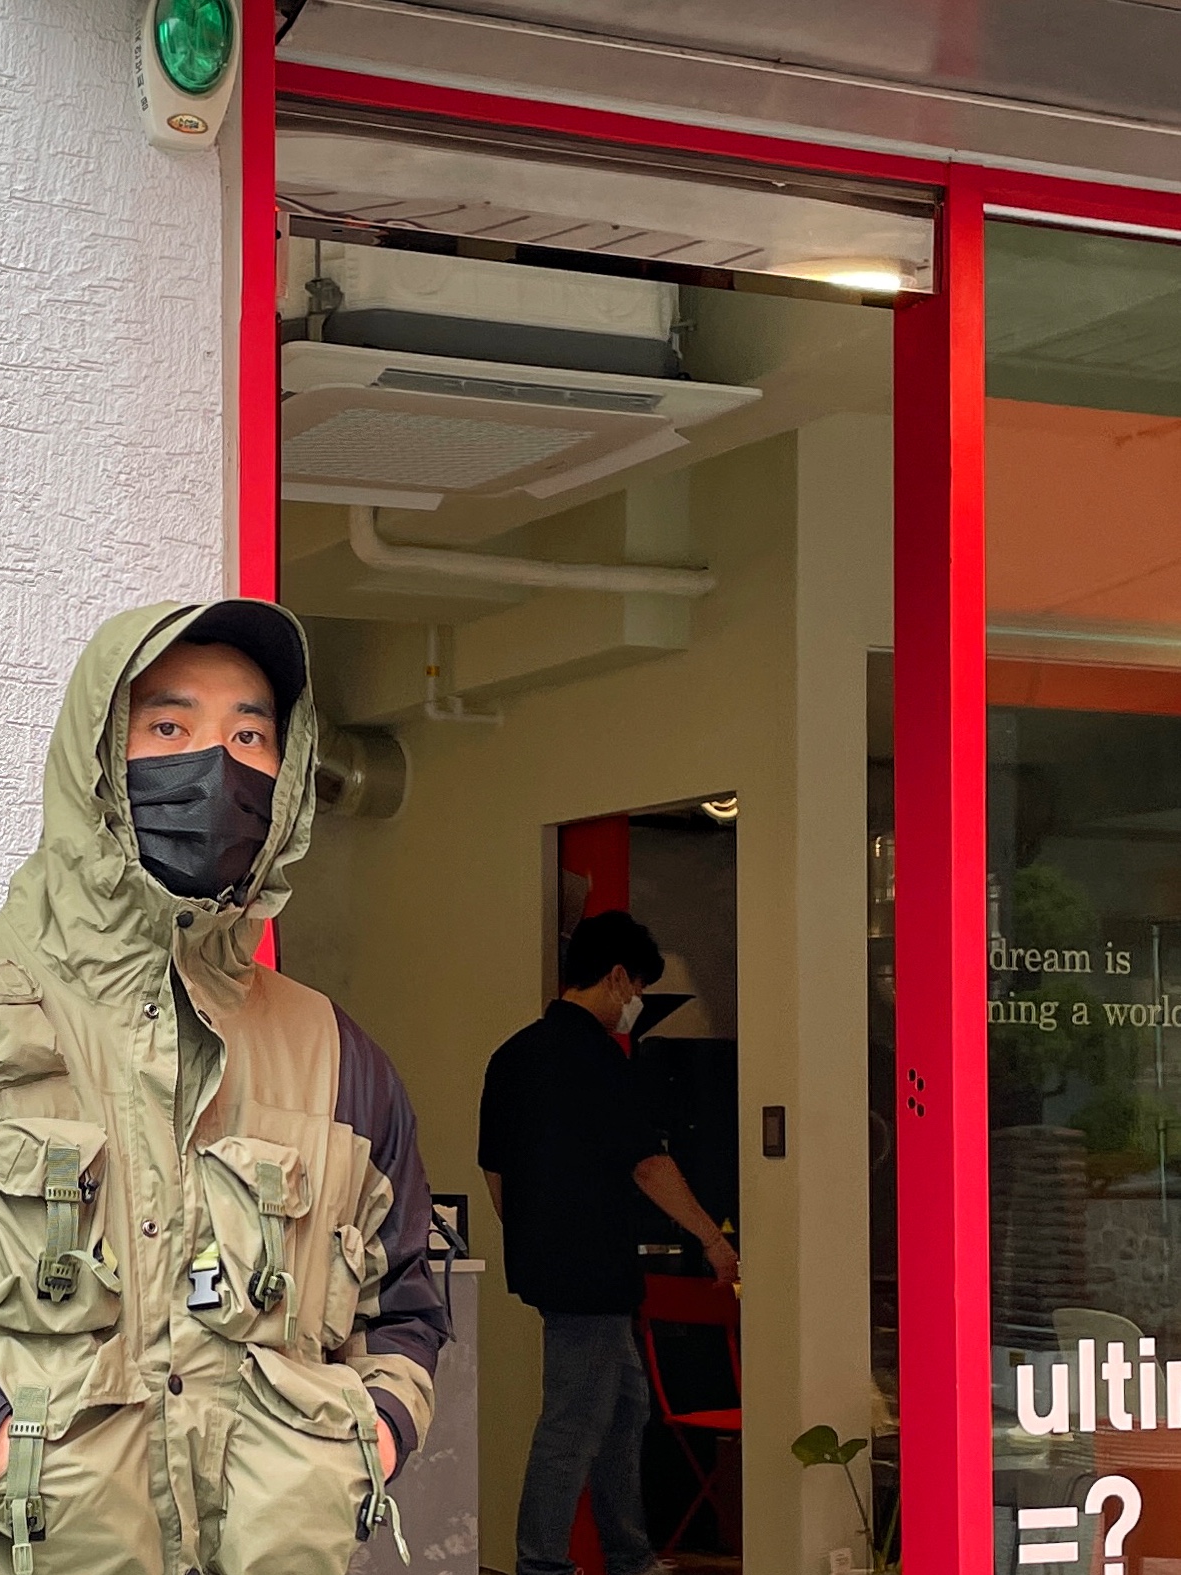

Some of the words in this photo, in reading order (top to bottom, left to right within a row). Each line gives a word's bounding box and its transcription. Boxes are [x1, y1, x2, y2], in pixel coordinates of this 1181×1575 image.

[989, 937, 1091, 973] dream
[1105, 941, 1131, 974] is
[1072, 1002, 1090, 1025] a
[1017, 1337, 1181, 1435] ulti
